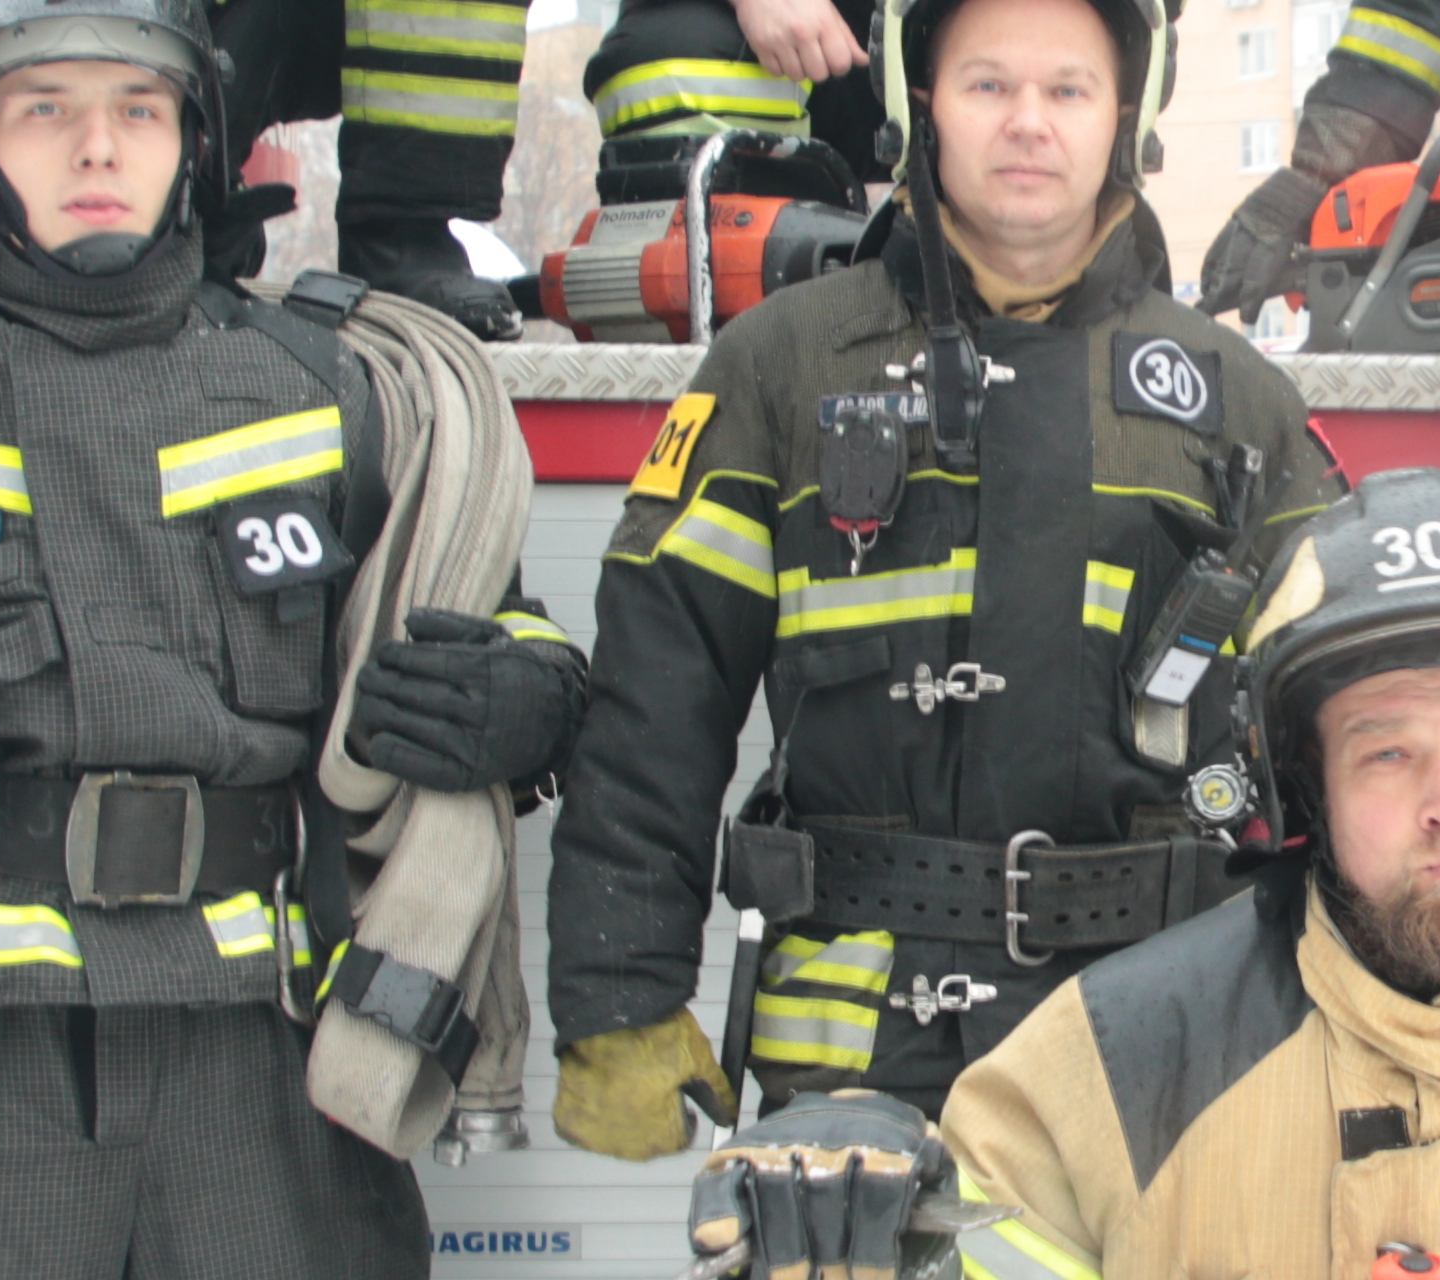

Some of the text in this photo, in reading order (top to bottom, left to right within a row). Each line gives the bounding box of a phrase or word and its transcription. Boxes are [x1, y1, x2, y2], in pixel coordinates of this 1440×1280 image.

[599, 207, 667, 224] holmatro
[1145, 352, 1193, 408] 30
[236, 512, 323, 576] 30
